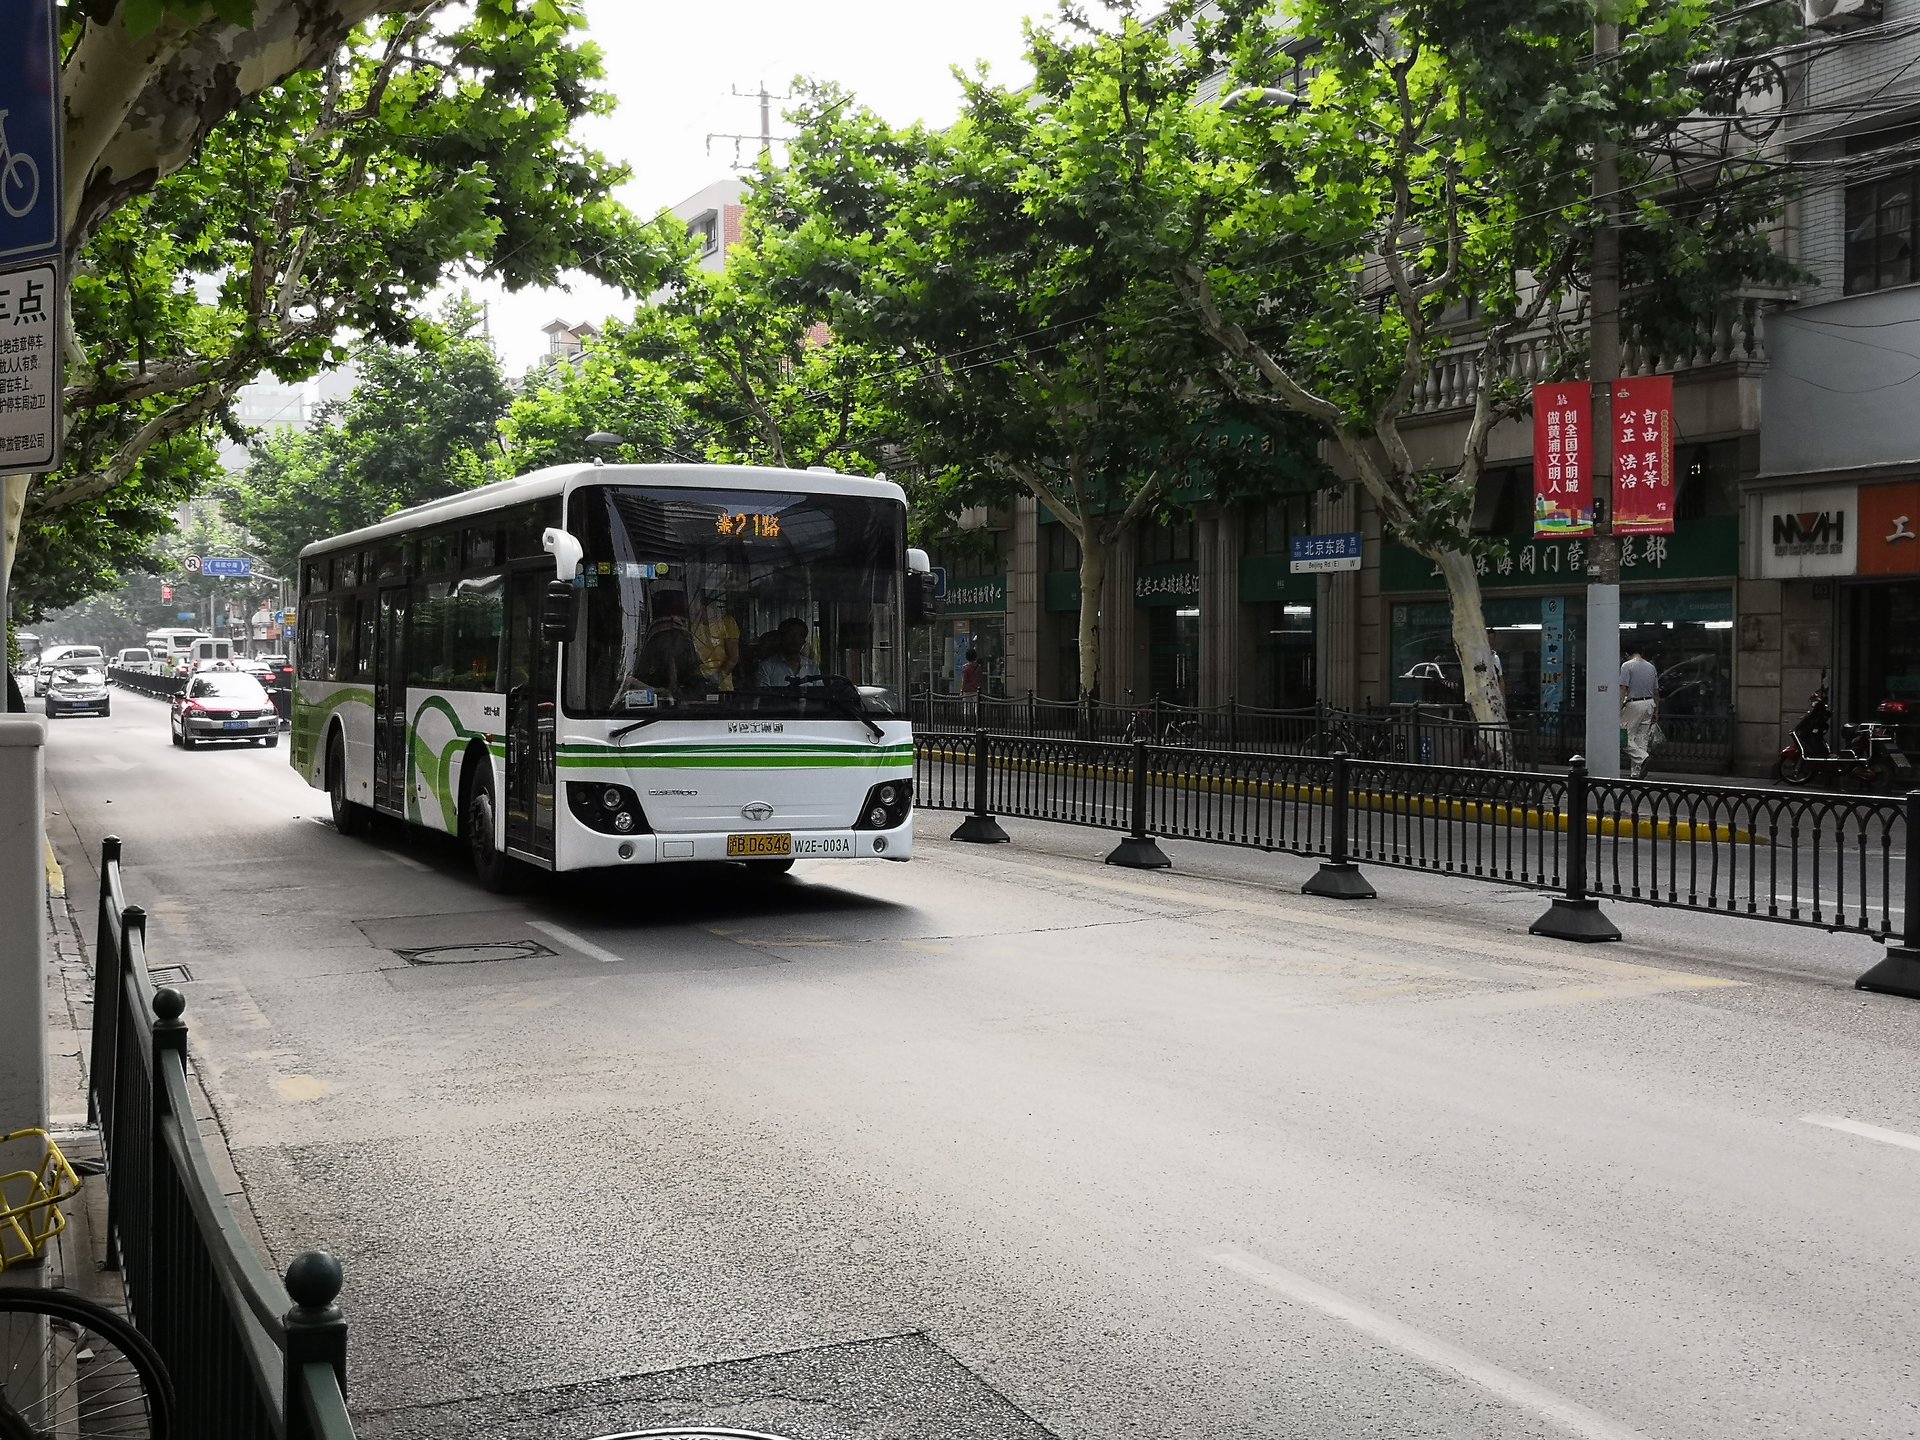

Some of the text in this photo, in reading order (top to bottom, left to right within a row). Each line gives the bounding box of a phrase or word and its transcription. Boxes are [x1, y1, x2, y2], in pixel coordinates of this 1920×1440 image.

[1547, 411, 1562, 494] 做黄浦文明人
[1564, 410, 1579, 493] 创全国文明城
[1619, 411, 1638, 490] 公正 法治
[1641, 409, 1660, 490] 自由 平等
[1305, 538, 1345, 556] 北京东路
[1885, 515, 1916, 542] 工
[1295, 562, 1300, 571] E
[1350, 559, 1356, 567] W
[1430, 535, 1668, 578] 上东海阀门管总部
[794, 839, 850, 853] W2E-003A
